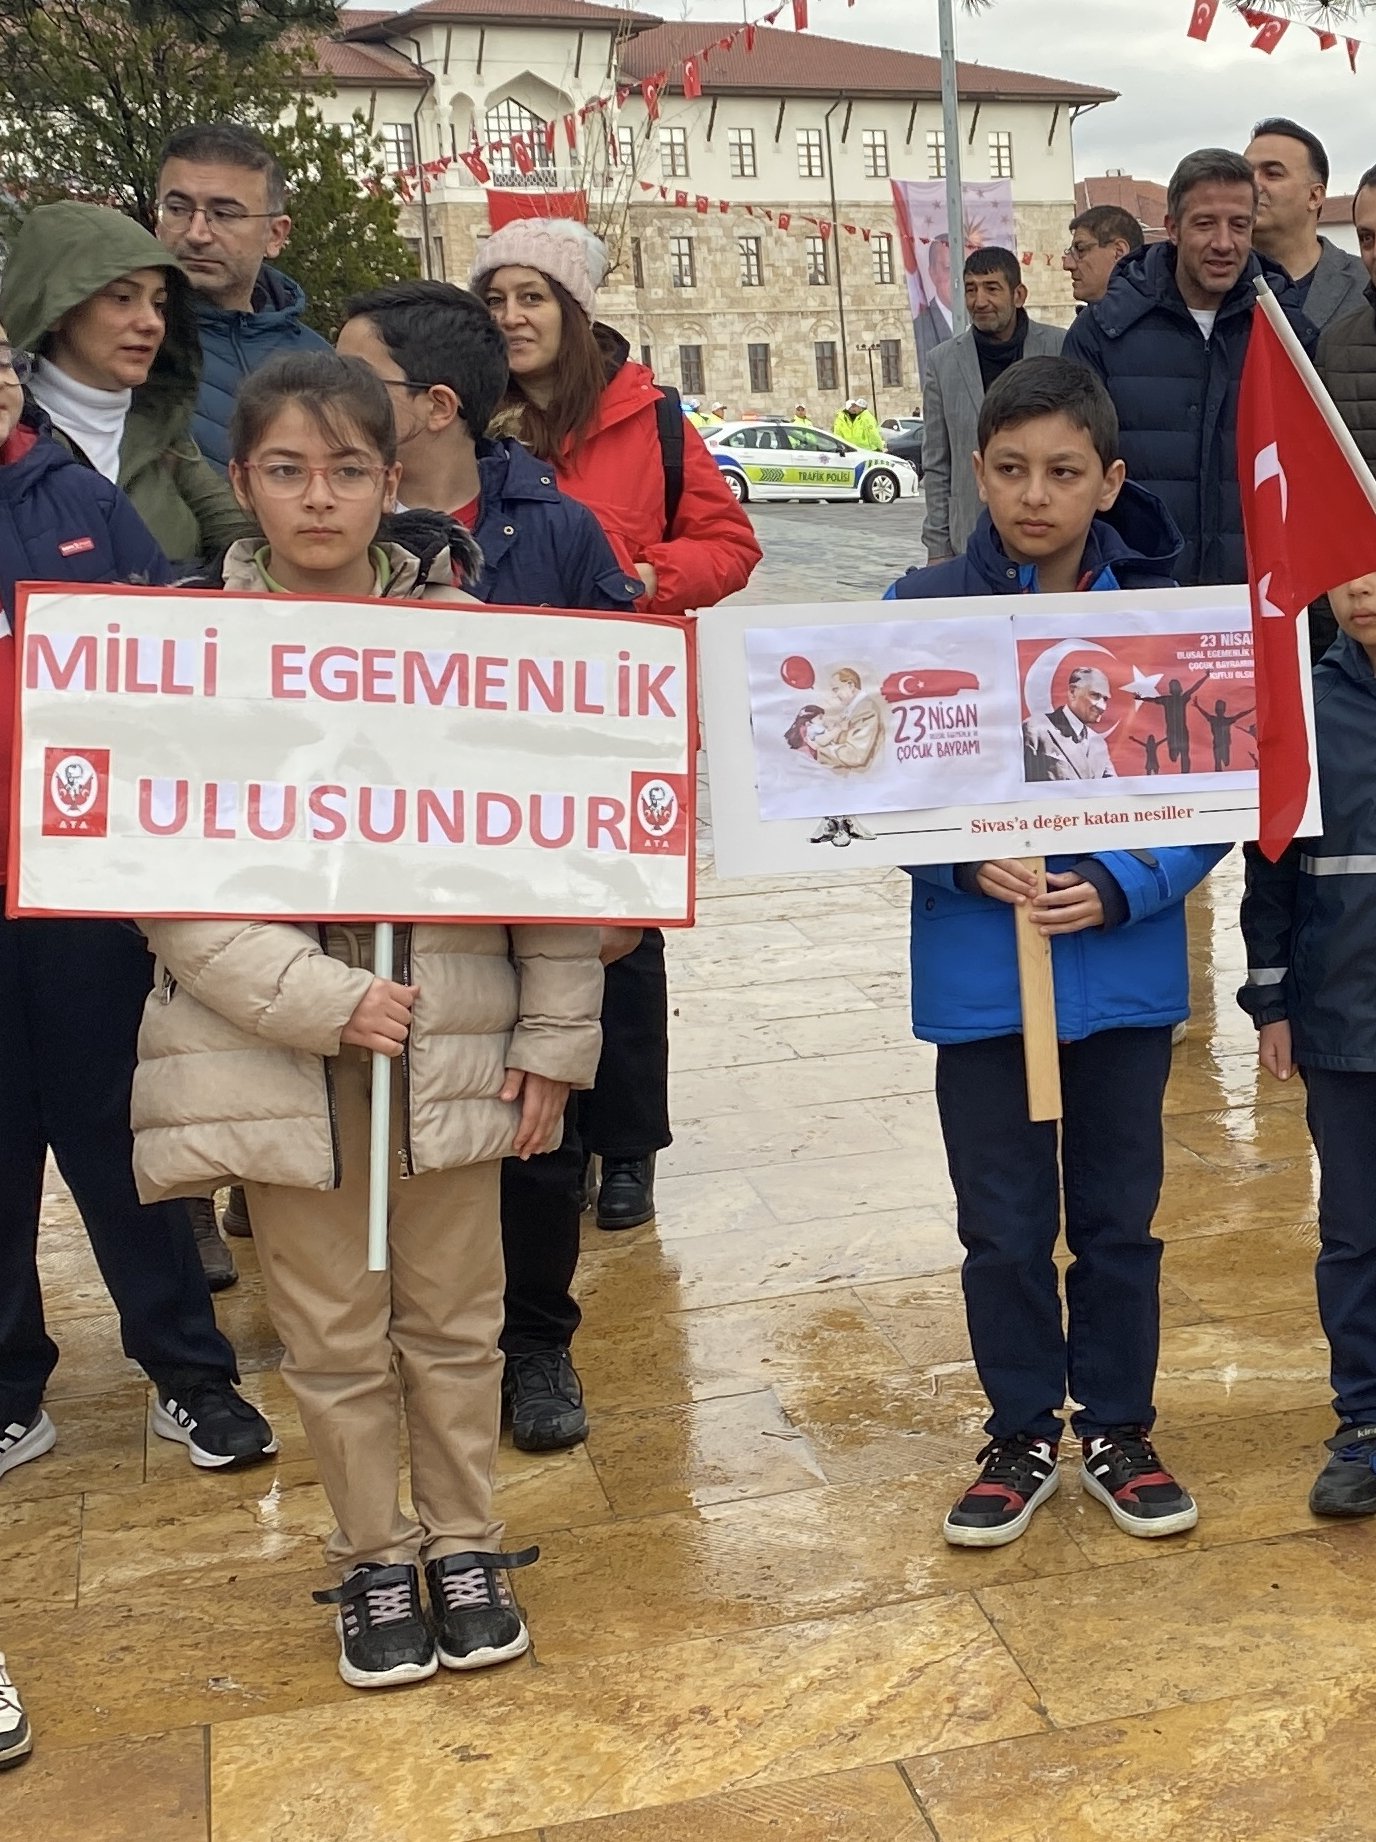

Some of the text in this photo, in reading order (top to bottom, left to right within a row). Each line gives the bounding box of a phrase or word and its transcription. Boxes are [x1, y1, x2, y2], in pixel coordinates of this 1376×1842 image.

[798, 471, 824, 481] TRAFİK
[1200, 634, 1217, 647] 23
[1176, 650, 1205, 659] ULUSAL
[26, 623, 677, 718] MİLLİ EGEMENLİK
[1188, 662, 1214, 671] ÇOCUK
[891, 701, 978, 743] 23 NİSAN
[897, 740, 980, 763] ÇOCUK BAYRAMI
[138, 778, 627, 851] ULUSUNDUR
[1033, 814, 1080, 831] değer
[1084, 811, 1130, 826] katan
[1134, 806, 1194, 822] nesiller
[59, 820, 88, 829] ATA
[644, 839, 669, 848] ATA
